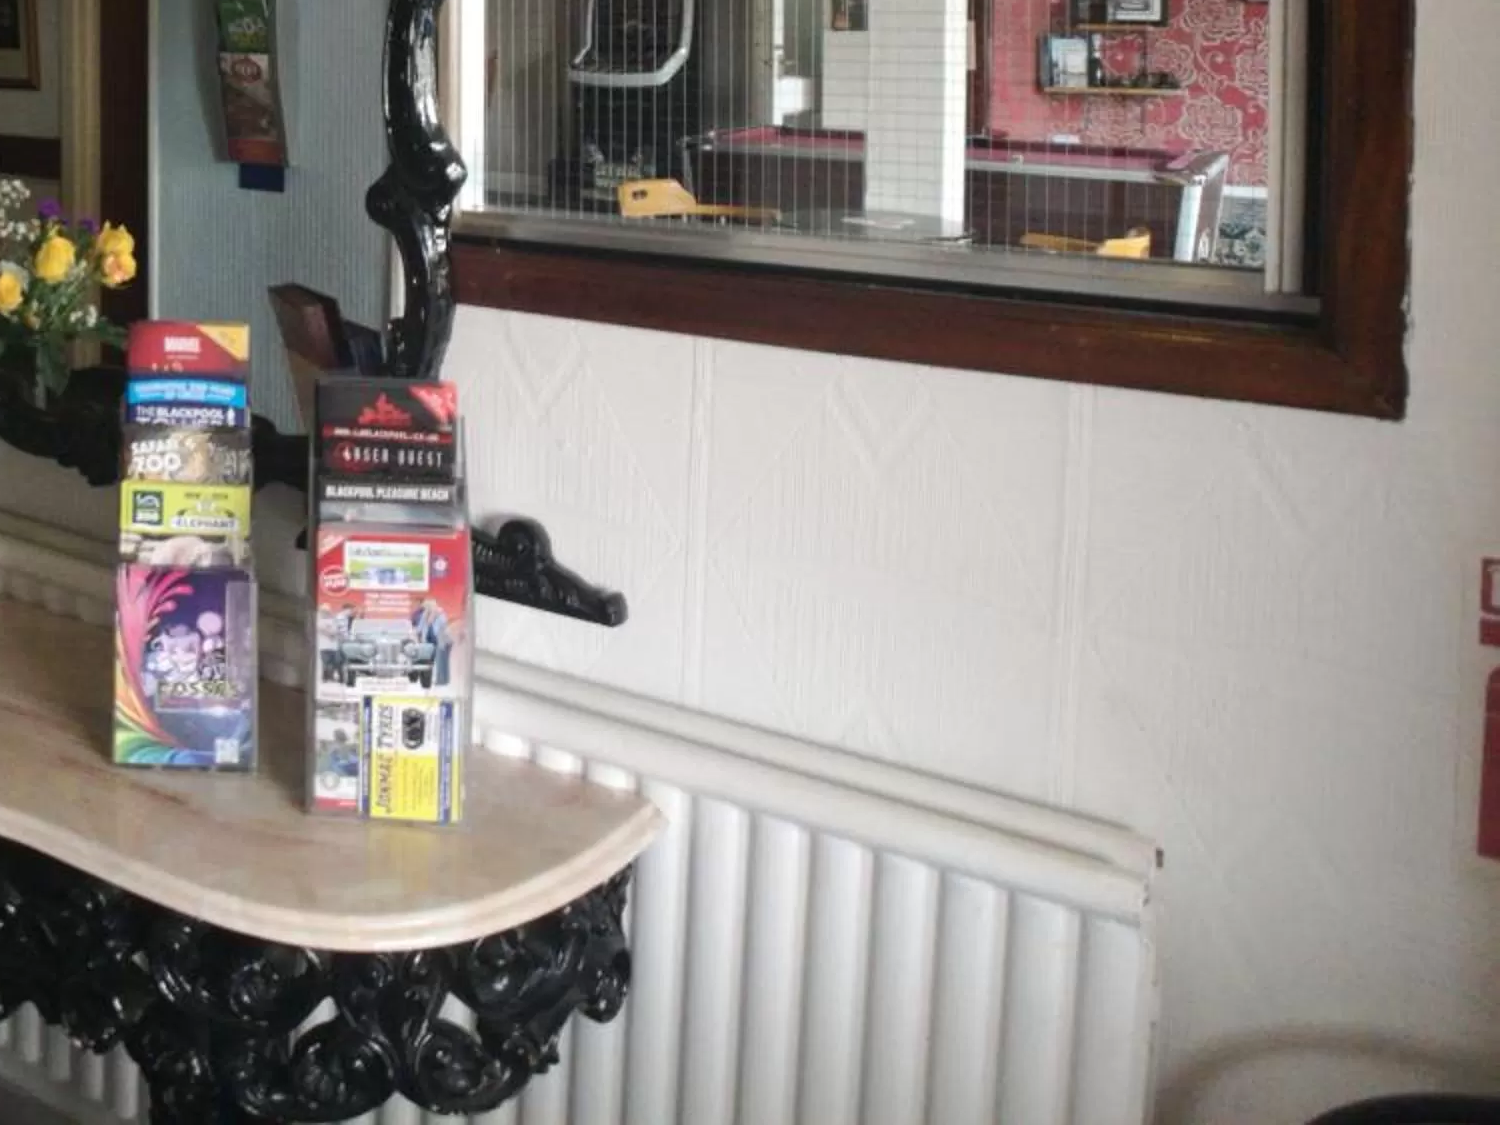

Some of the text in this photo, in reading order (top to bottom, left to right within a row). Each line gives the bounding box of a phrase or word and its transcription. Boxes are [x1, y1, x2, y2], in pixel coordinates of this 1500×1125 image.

[155, 406, 224, 420] BLACKPOOL
[130, 452, 181, 473] ZOO
[397, 447, 443, 469] QUEST
[325, 484, 450, 502] BLACKPOOL PLEASURE BEACH
